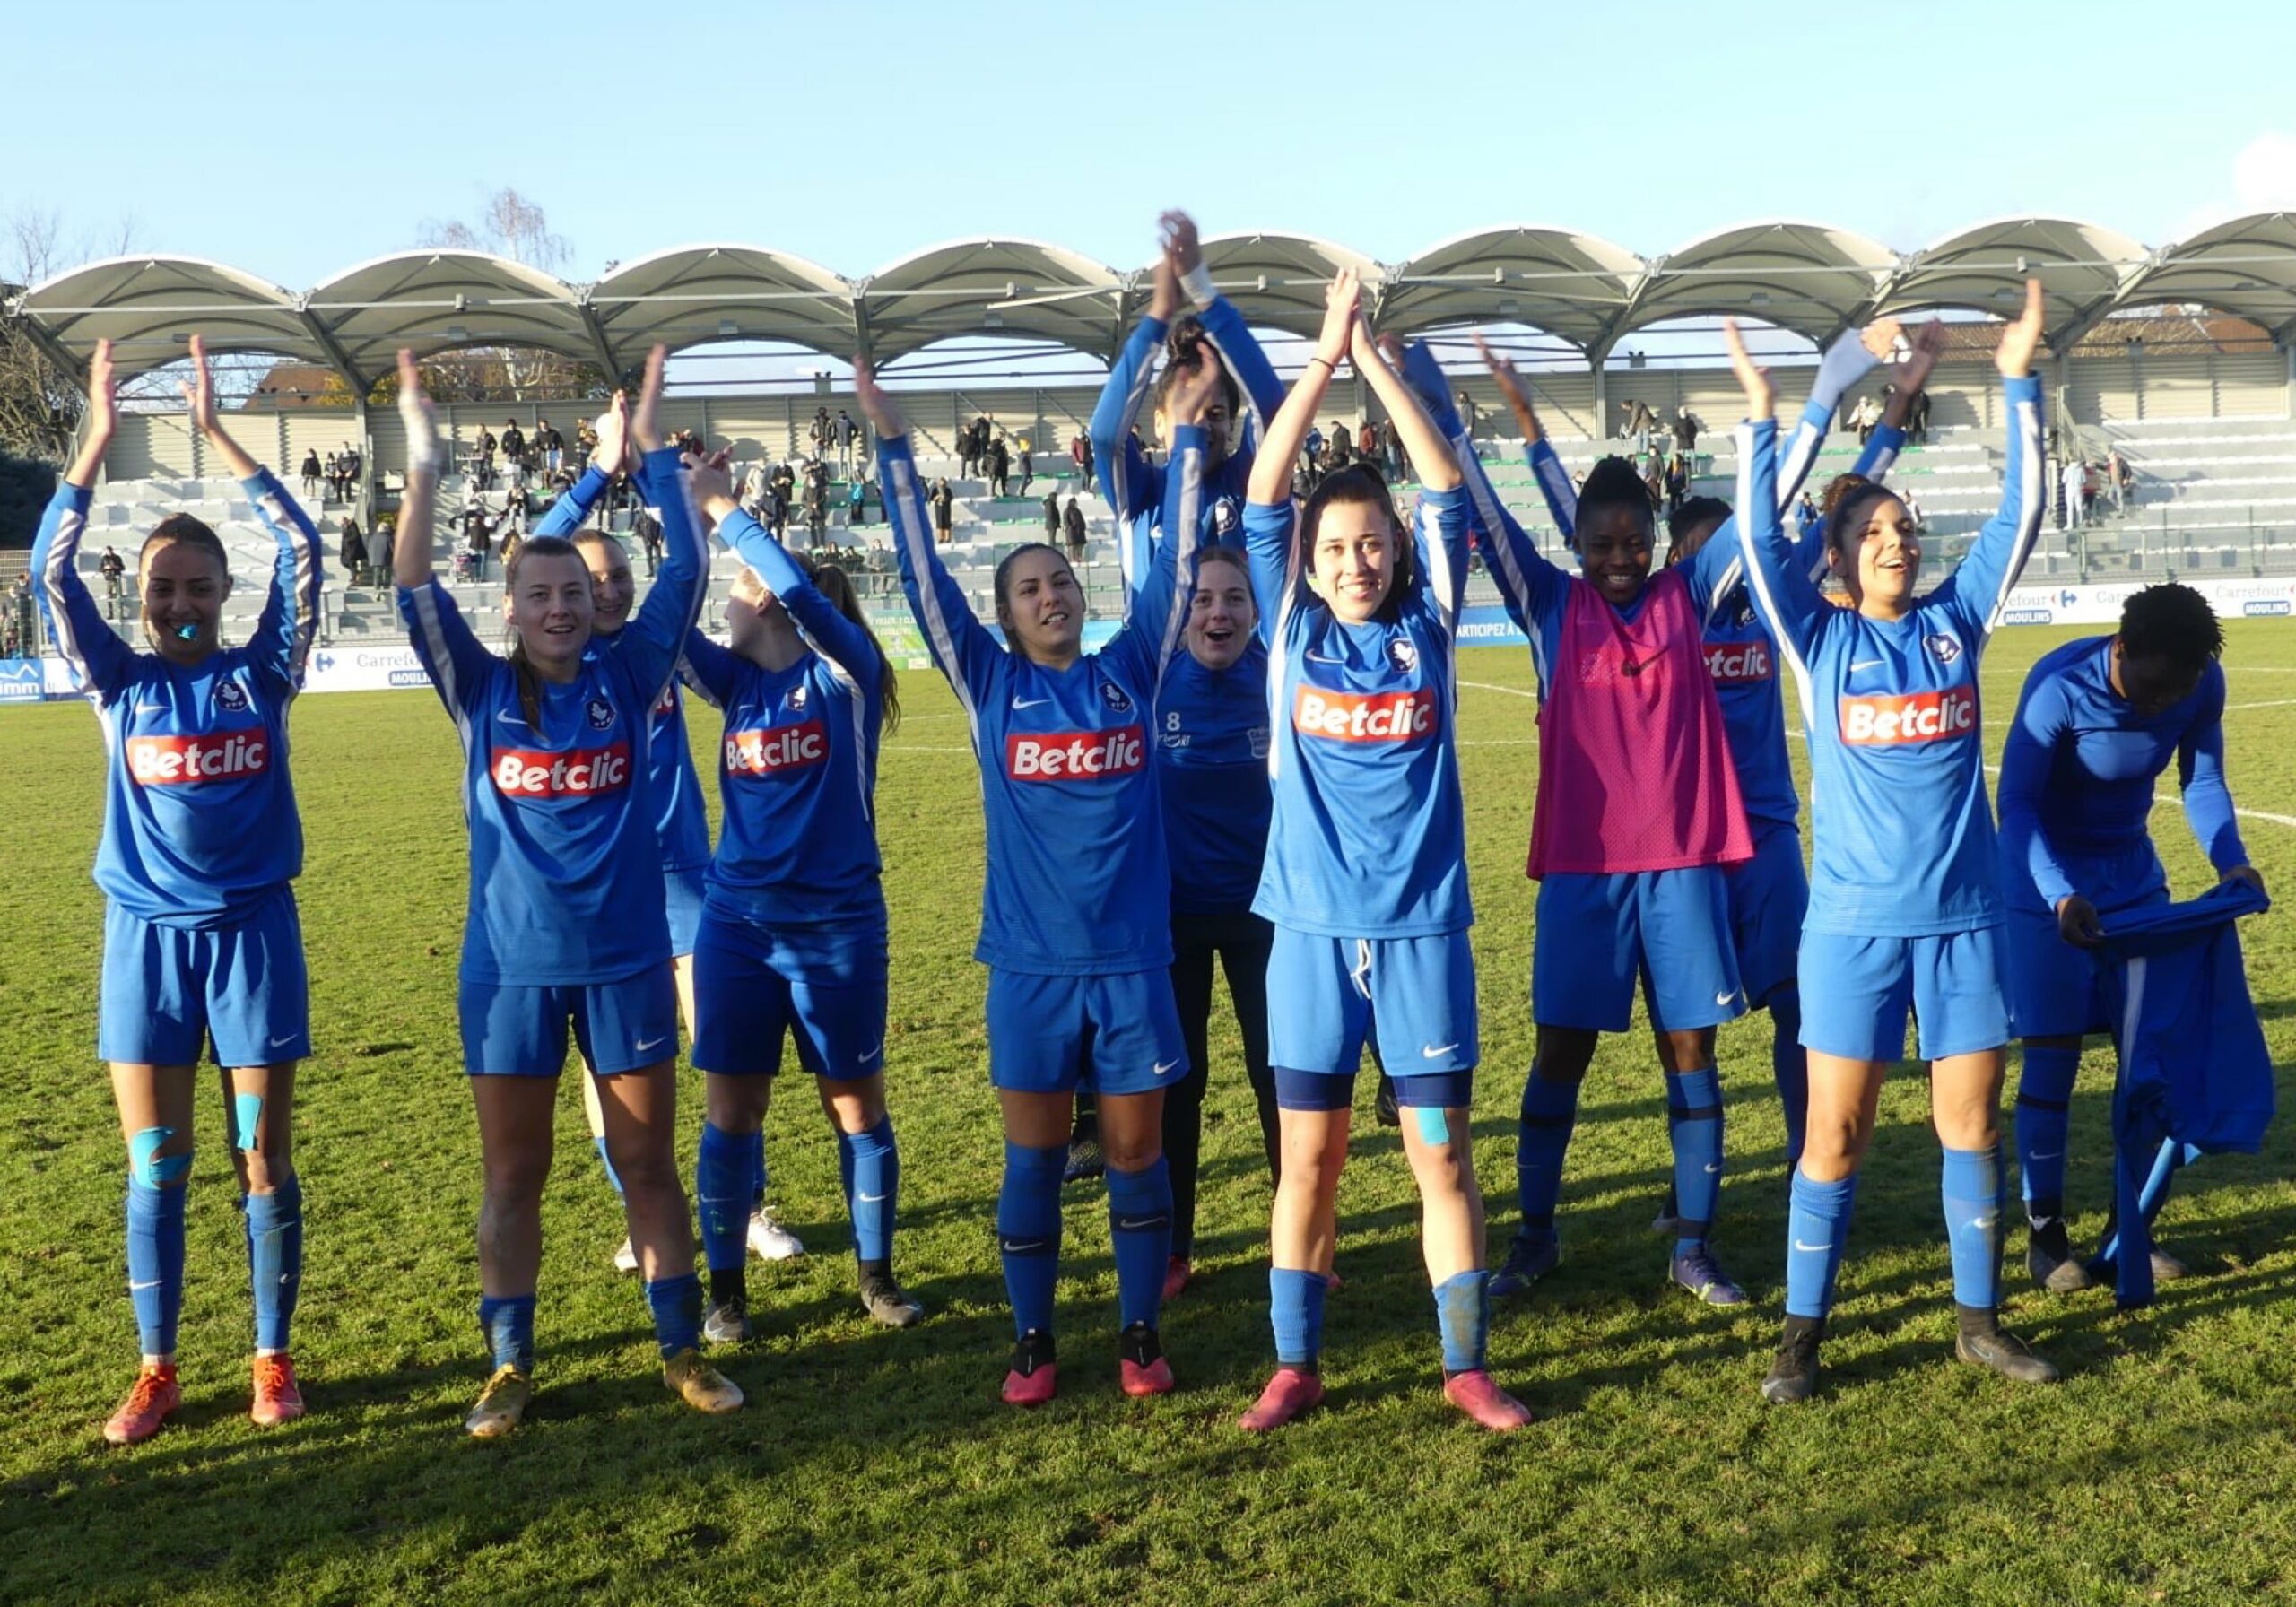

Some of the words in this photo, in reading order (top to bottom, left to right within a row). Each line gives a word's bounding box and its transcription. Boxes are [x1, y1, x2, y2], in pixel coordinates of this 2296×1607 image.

[2007, 594, 2048, 606] efour
[2216, 585, 2286, 599] Carrefour
[1456, 623, 1506, 638] ARTICIPEZ
[357, 651, 419, 668] Carrefo
[1704, 646, 1767, 677] tclic
[392, 672, 431, 684] MOULI
[1167, 712, 1180, 731] 8
[1300, 693, 1430, 736] Betclic
[1847, 694, 1971, 740] Betclic
[135, 735, 264, 778] Betclic
[726, 729, 822, 770] Betclic
[1013, 733, 1140, 776] Betclic
[496, 751, 625, 792] Betclic
